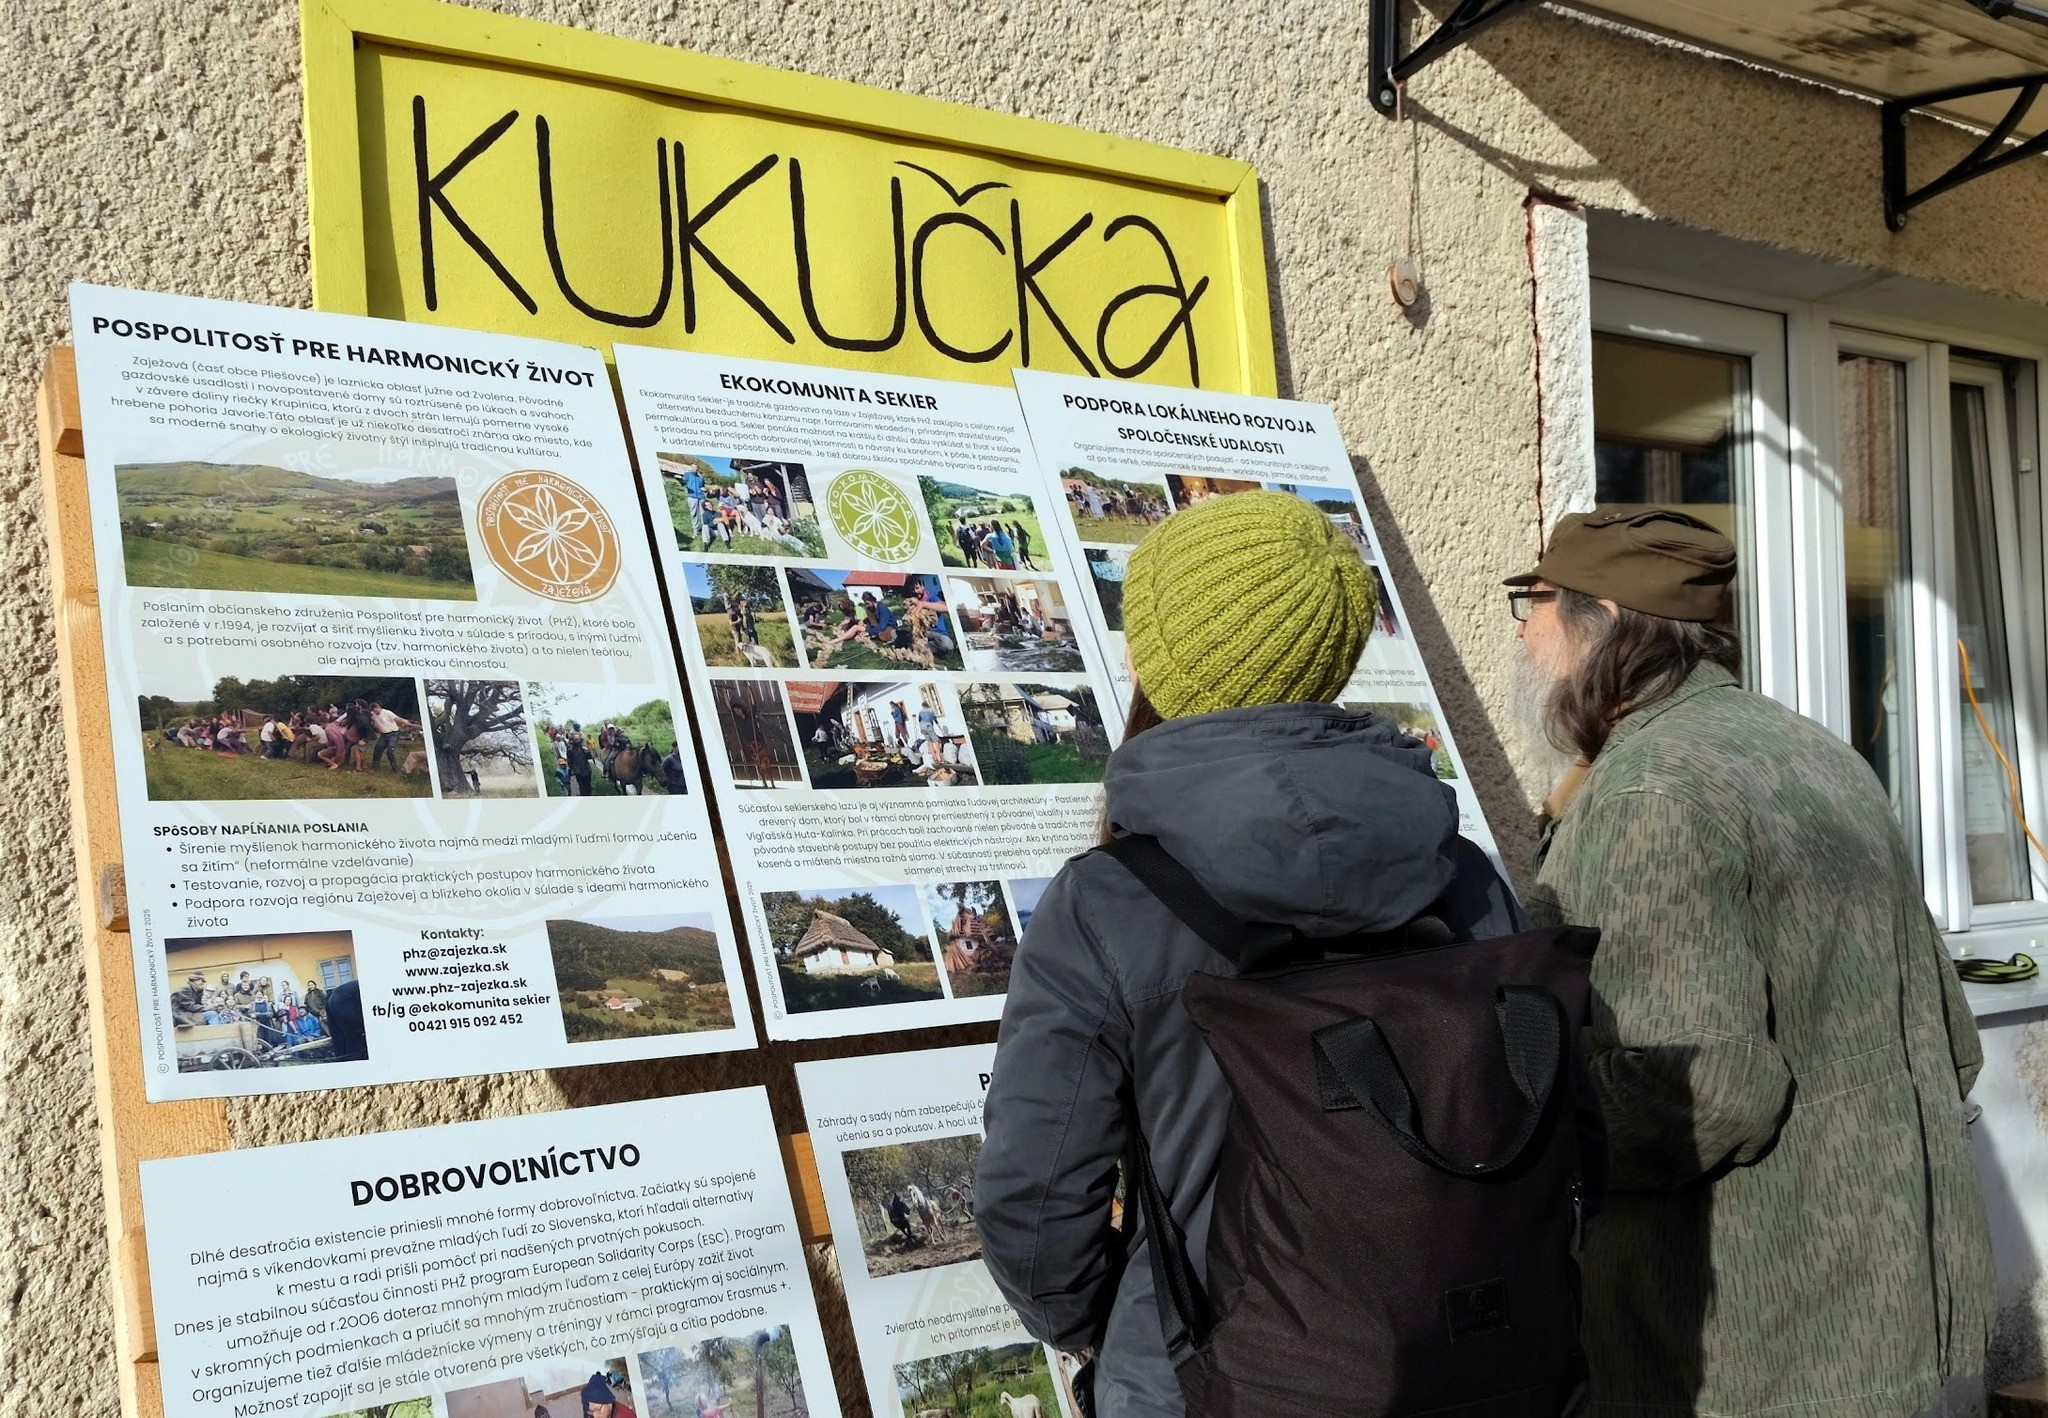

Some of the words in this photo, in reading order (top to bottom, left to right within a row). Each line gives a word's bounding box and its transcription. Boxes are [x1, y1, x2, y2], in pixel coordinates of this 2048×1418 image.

[92, 316, 285, 354] POSPOLITOSŤ
[292, 338, 341, 360] PRE
[346, 344, 520, 379] HARMONICKÝ
[525, 360, 595, 388] ŽIVOT
[132, 355, 189, 370] Zaježová
[191, 360, 225, 374] (časť
[226, 366, 258, 377] obce
[260, 369, 321, 385] Pliešovce)
[323, 375, 335, 387] je
[386, 382, 422, 394] oblasť
[424, 385, 453, 397] južne
[455, 390, 470, 398] od
[472, 390, 517, 403] Zvolena.
[518, 395, 564, 408] Pôvodné
[719, 373, 872, 404] EKOKOMUNITA
[874, 390, 938, 411] SEKIER
[121, 370, 190, 384] gazdovské
[192, 377, 249, 390] usadlosti
[257, 384, 350, 400] novopostavené
[352, 391, 386, 405] domy
[388, 395, 402, 405] sú
[404, 398, 463, 411] roztrúsené
[464, 404, 480, 413] po
[481, 403, 518, 416] lúkach
[519, 409, 528, 417] a
[529, 410, 574, 421] svahoch
[1062, 394, 1146, 417] PODPORA
[1147, 403, 1241, 426] LOKÁLNEHO
[1242, 413, 1316, 434] ROZVOJA
[1117, 427, 1218, 449] SPOLOČENSKÉ
[1218, 437, 1285, 455] UDALOSTI
[143, 601, 205, 613] Poslaním
[208, 604, 292, 617] občianskeho
[294, 607, 354, 619] združenia
[356, 609, 422, 623] Pospolitosť
[424, 613, 445, 624] pre
[446, 613, 515, 627] harmonický
[517, 615, 543, 626] život
[581, 617, 610, 628] ktoré
[611, 619, 636, 629] bolo
[317, 654, 337, 665] ale
[340, 655, 380, 668] najmä
[383, 656, 446, 669] praktickou
[448, 657, 509, 669] činnosťou.
[737, 803, 783, 814] Súčasťou
[783, 802, 838, 812] sekierskeho
[857, 800, 868, 812] je
[925, 798, 967, 810] pamiatka
[966, 797, 1000, 808] ľudovej
[221, 821, 301, 835] NAPĹŇANIA
[303, 822, 369, 833] POSLANIA
[179, 841, 226, 854] Šírenie
[229, 840, 299, 856] myšlienok
[301, 838, 396, 851] harmonického
[398, 837, 436, 849] života
[438, 836, 479, 850] najmä
[482, 835, 519, 846] medzi
[520, 833, 573, 847] mladými
[575, 832, 611, 844] ľuďmi
[612, 832, 654, 843] formou
[181, 863, 198, 873] sa
[244, 857, 328, 873] (neformálne
[331, 852, 414, 868] vzdelávanie)
[903, 864, 945, 876] slamenej
[944, 863, 977, 875] strechy
[977, 864, 989, 872] za
[143, 909, 151, 928] 2025
[420, 927, 484, 941] Kontakty:
[402, 943, 507, 963] phz@zajezka.sk
[405, 960, 510, 977] www.zajezka.sk
[391, 977, 528, 997] www.phz-zajezka.sk
[372, 1001, 406, 1018] fb/ig
[408, 996, 510, 1017] @ekokomunita
[512, 993, 551, 1006] sekier
[408, 1019, 447, 1032] 00421
[449, 1017, 471, 1029] 915
[473, 1015, 497, 1027] 092
[499, 1013, 523, 1025] 452
[816, 1114, 858, 1129] Záhrady
[859, 1114, 867, 1123] a
[868, 1110, 892, 1123] sady
[894, 1107, 917, 1119] nám
[918, 1099, 976, 1116] zabezpečujú
[836, 1129, 870, 1143] učenia
[871, 1128, 884, 1138] sa
[885, 1127, 893, 1136] a
[894, 1122, 937, 1138] pokusov.
[937, 1119, 945, 1129] A
[944, 1116, 967, 1128] hoci
[966, 1114, 978, 1126] už
[350, 1143, 640, 1207] DOBROVOĽNÍCTVO
[190, 1248, 225, 1266] Dlhé
[228, 1236, 311, 1260] desaťročia
[314, 1225, 386, 1247] existencie
[389, 1215, 443, 1239] priniesli
[446, 1208, 494, 1227] mnohé
[497, 1204, 536, 1219] formy
[539, 1189, 639, 1213] dobrovoľníctva.
[640, 1180, 691, 1197] Začiatky
[693, 1176, 708, 1189] sú
[710, 1168, 756, 1189] spojené
[174, 1319, 214, 1336] Dnes
[217, 1315, 232, 1333] je
[236, 1304, 307, 1326] stabilnou
[311, 1291, 379, 1313] súčasťou
[382, 1278, 438, 1301] činnosti
[441, 1272, 467, 1290] PHŽ
[469, 1266, 530, 1289] program
[532, 1255, 595, 1275] European
[597, 1244, 655, 1264] Solidarity
[657, 1238, 695, 1254] Corps
[697, 1227, 733, 1249] (ESC).
[734, 1223, 786, 1241] Program
[884, 1317, 926, 1335] Zvieratá
[930, 1331, 947, 1344] Ich
[1000, 1318, 1011, 1333] je
